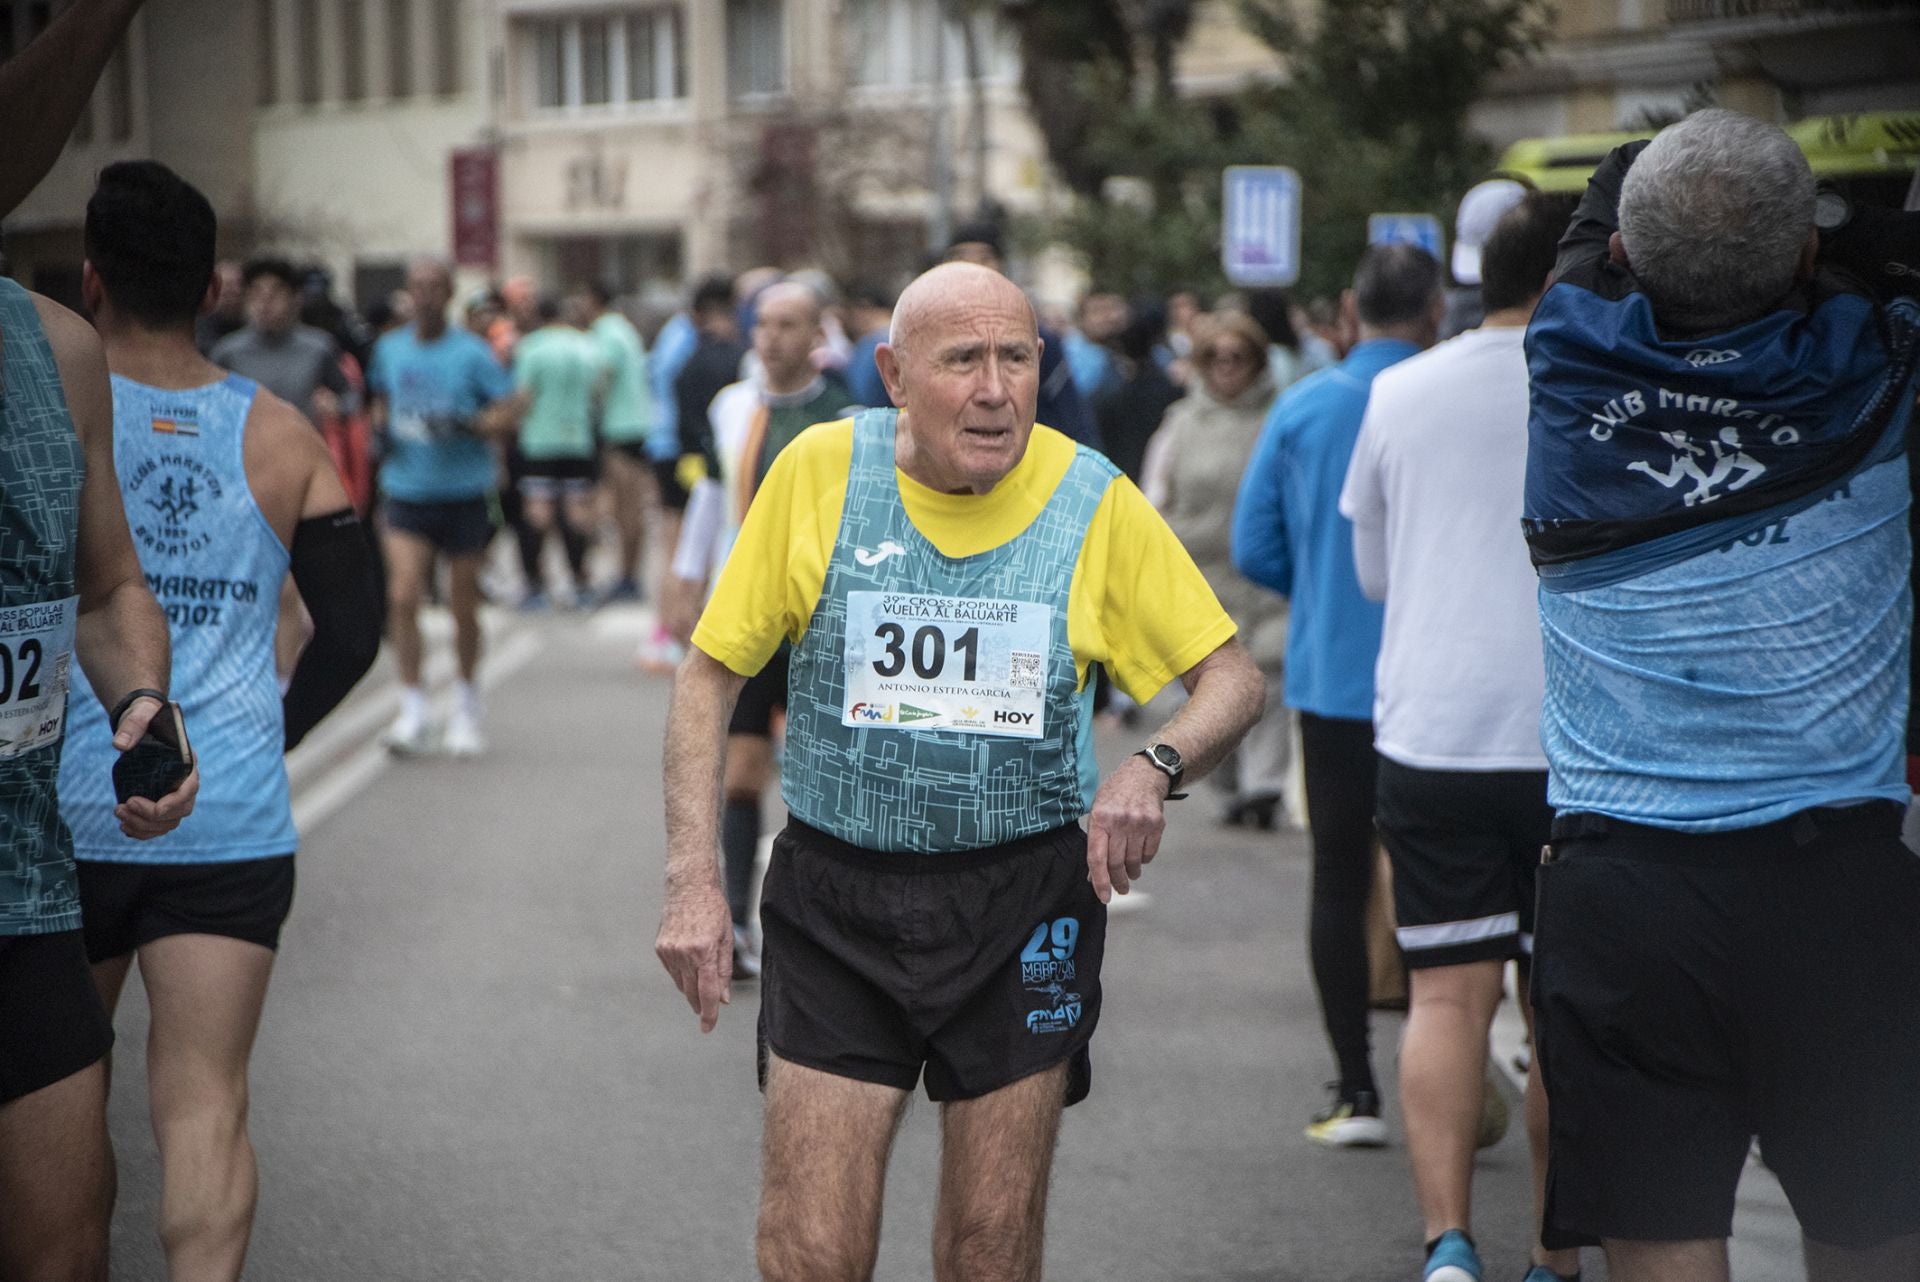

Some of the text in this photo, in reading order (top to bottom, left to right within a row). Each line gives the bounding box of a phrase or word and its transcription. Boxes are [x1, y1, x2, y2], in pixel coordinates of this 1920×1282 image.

[1590, 389, 1647, 441] CLUB
[135, 525, 212, 558] BADAJOZ
[882, 603, 930, 617] VUELTA
[934, 607, 950, 619] AL
[954, 608, 1018, 623] BALUARTE
[909, 596, 954, 608] CROSS
[957, 600, 1018, 611] POPULAR
[0, 610, 17, 620] SS
[872, 622, 979, 682] 301
[878, 683, 1011, 698] ANTONIO ESTEPA GARCÍA
[39, 716, 59, 736] HOY
[993, 710, 1034, 725] HOY
[1020, 916, 1080, 962] 29
[1022, 960, 1075, 977] MARATON
